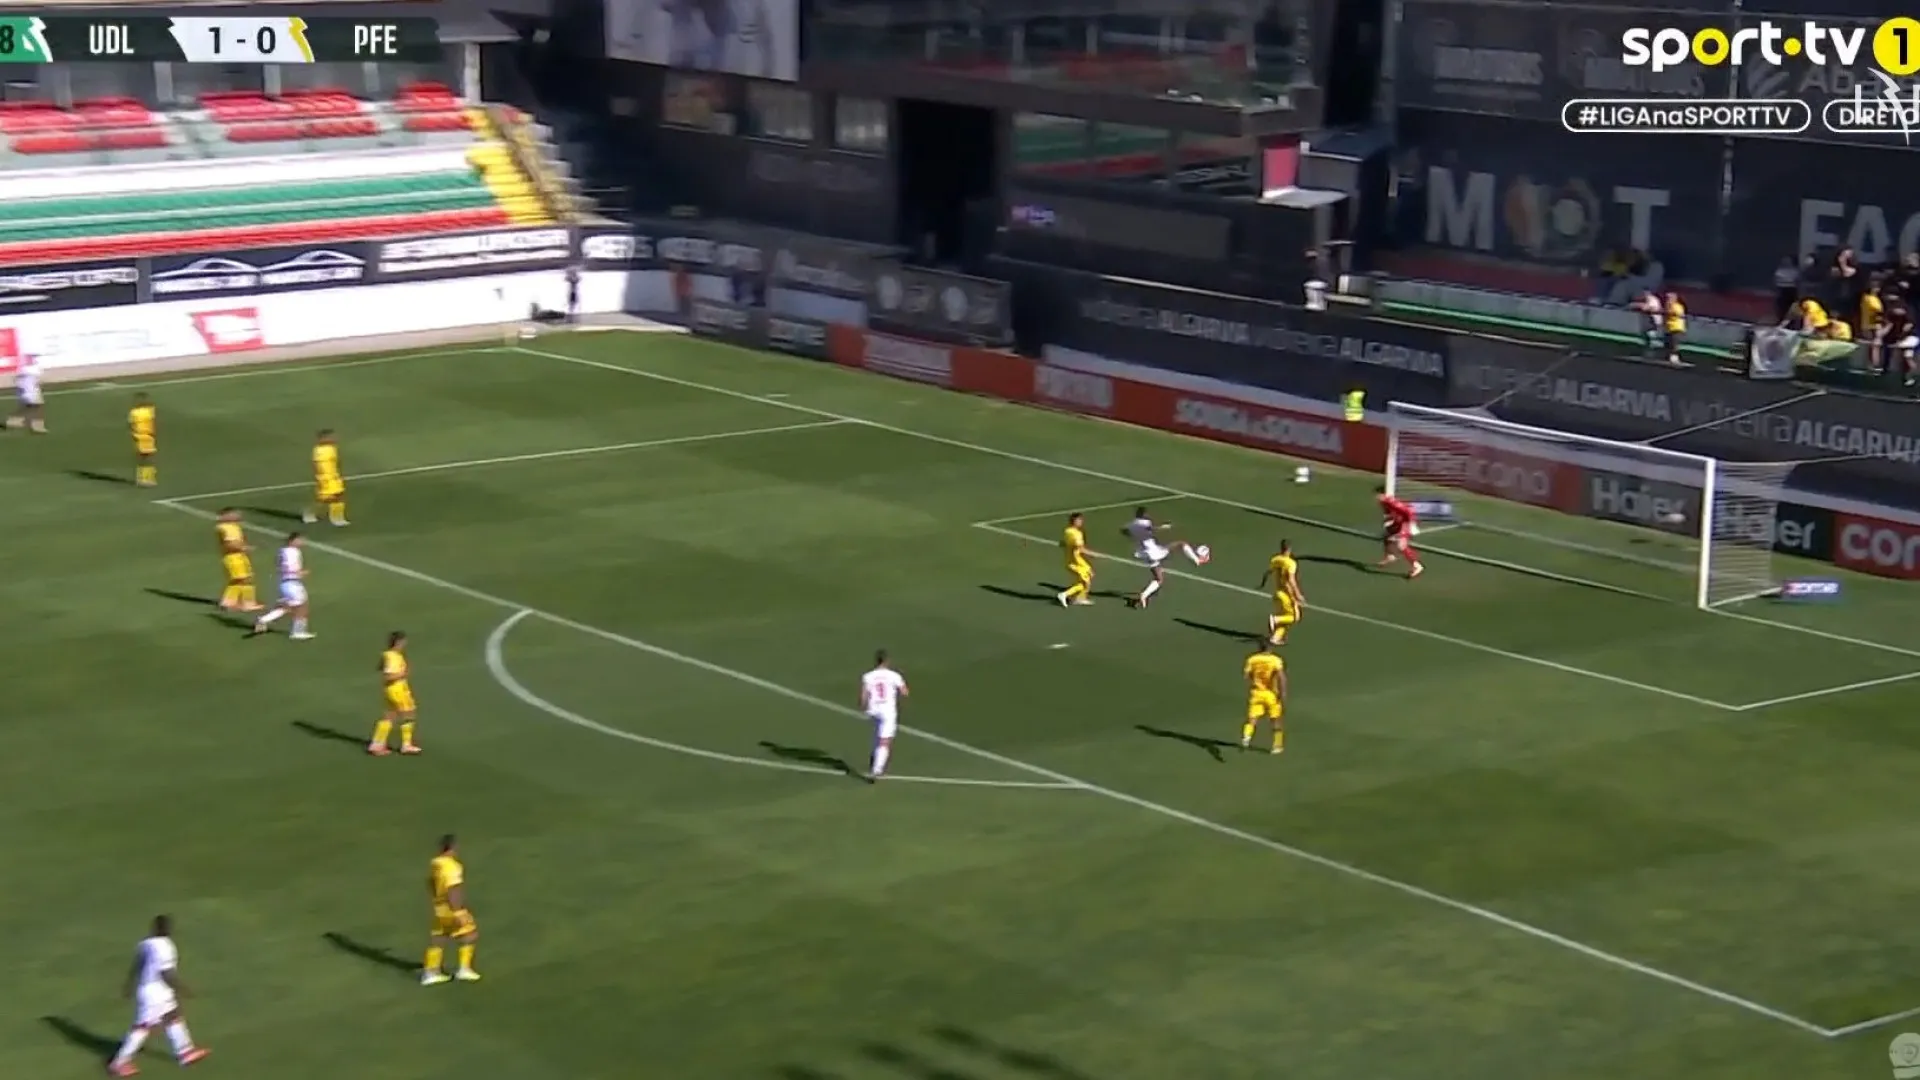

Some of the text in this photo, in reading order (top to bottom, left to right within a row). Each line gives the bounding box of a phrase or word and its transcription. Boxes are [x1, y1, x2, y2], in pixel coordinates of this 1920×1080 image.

[1340, 337, 1444, 377] ALGARVIA
[1552, 377, 1671, 422] ALGARVIA
[1591, 475, 1687, 524] Haier
